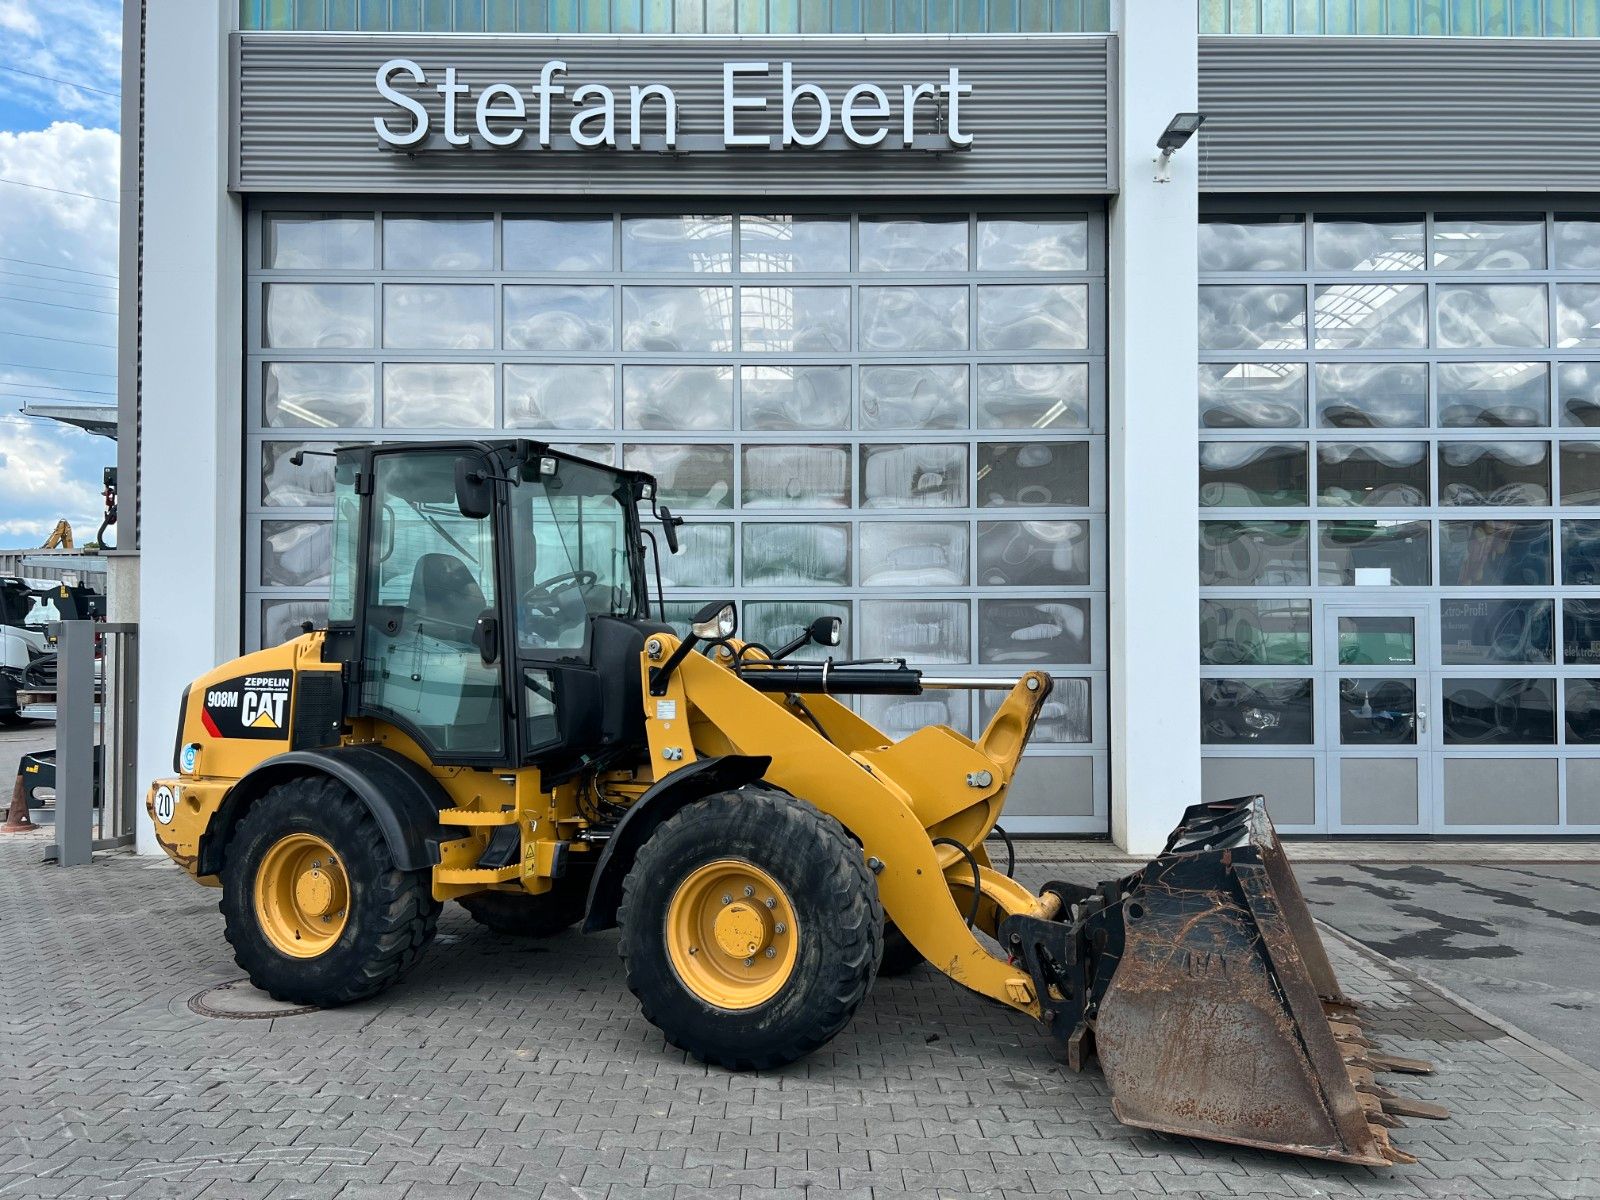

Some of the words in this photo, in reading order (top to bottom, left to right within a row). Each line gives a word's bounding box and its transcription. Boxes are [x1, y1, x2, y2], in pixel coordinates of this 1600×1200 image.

[374, 59, 677, 147] Stefan
[723, 61, 975, 147] Ebert
[244, 677, 290, 687] ZEPPELIN
[207, 691, 239, 708] 908M
[241, 691, 288, 728] CAT
[158, 793, 171, 817] 20
